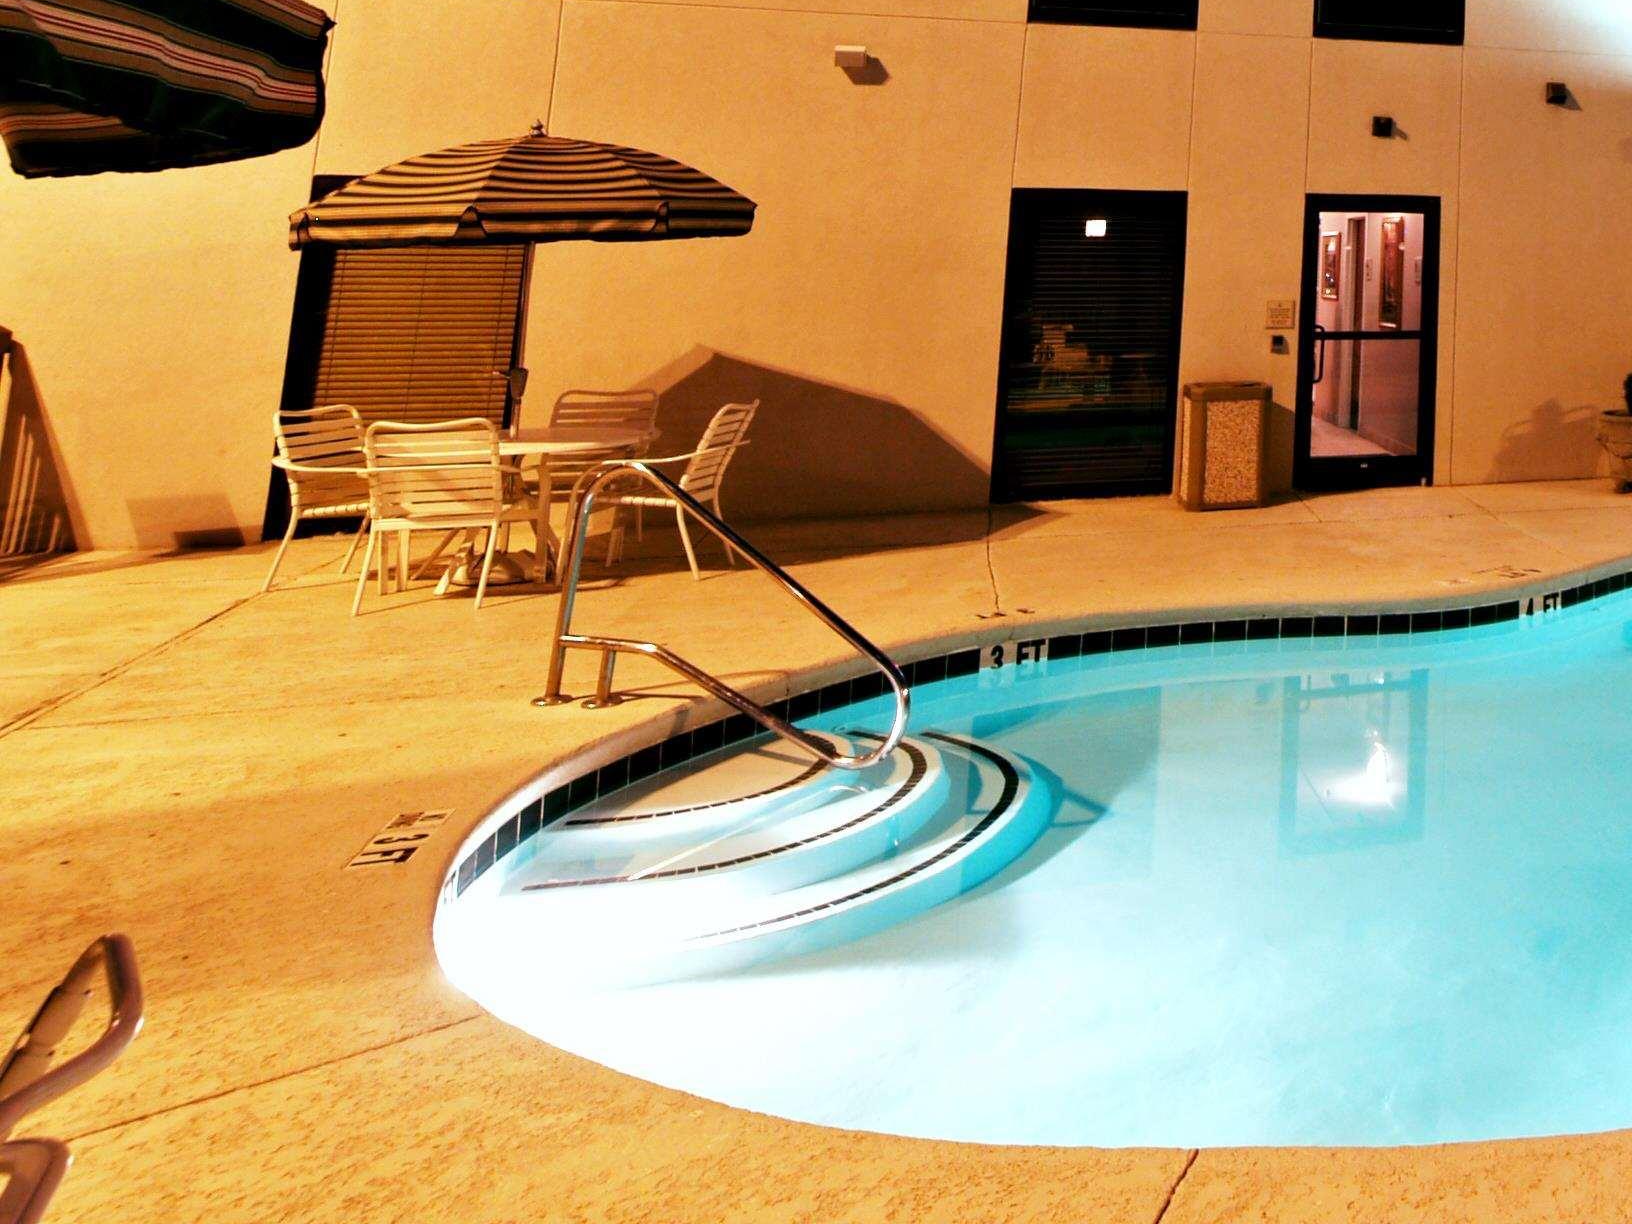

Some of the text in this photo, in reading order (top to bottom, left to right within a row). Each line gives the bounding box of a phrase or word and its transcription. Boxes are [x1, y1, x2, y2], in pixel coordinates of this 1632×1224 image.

[1543, 592, 1560, 613] FT
[990, 638, 1046, 669] 3 FT
